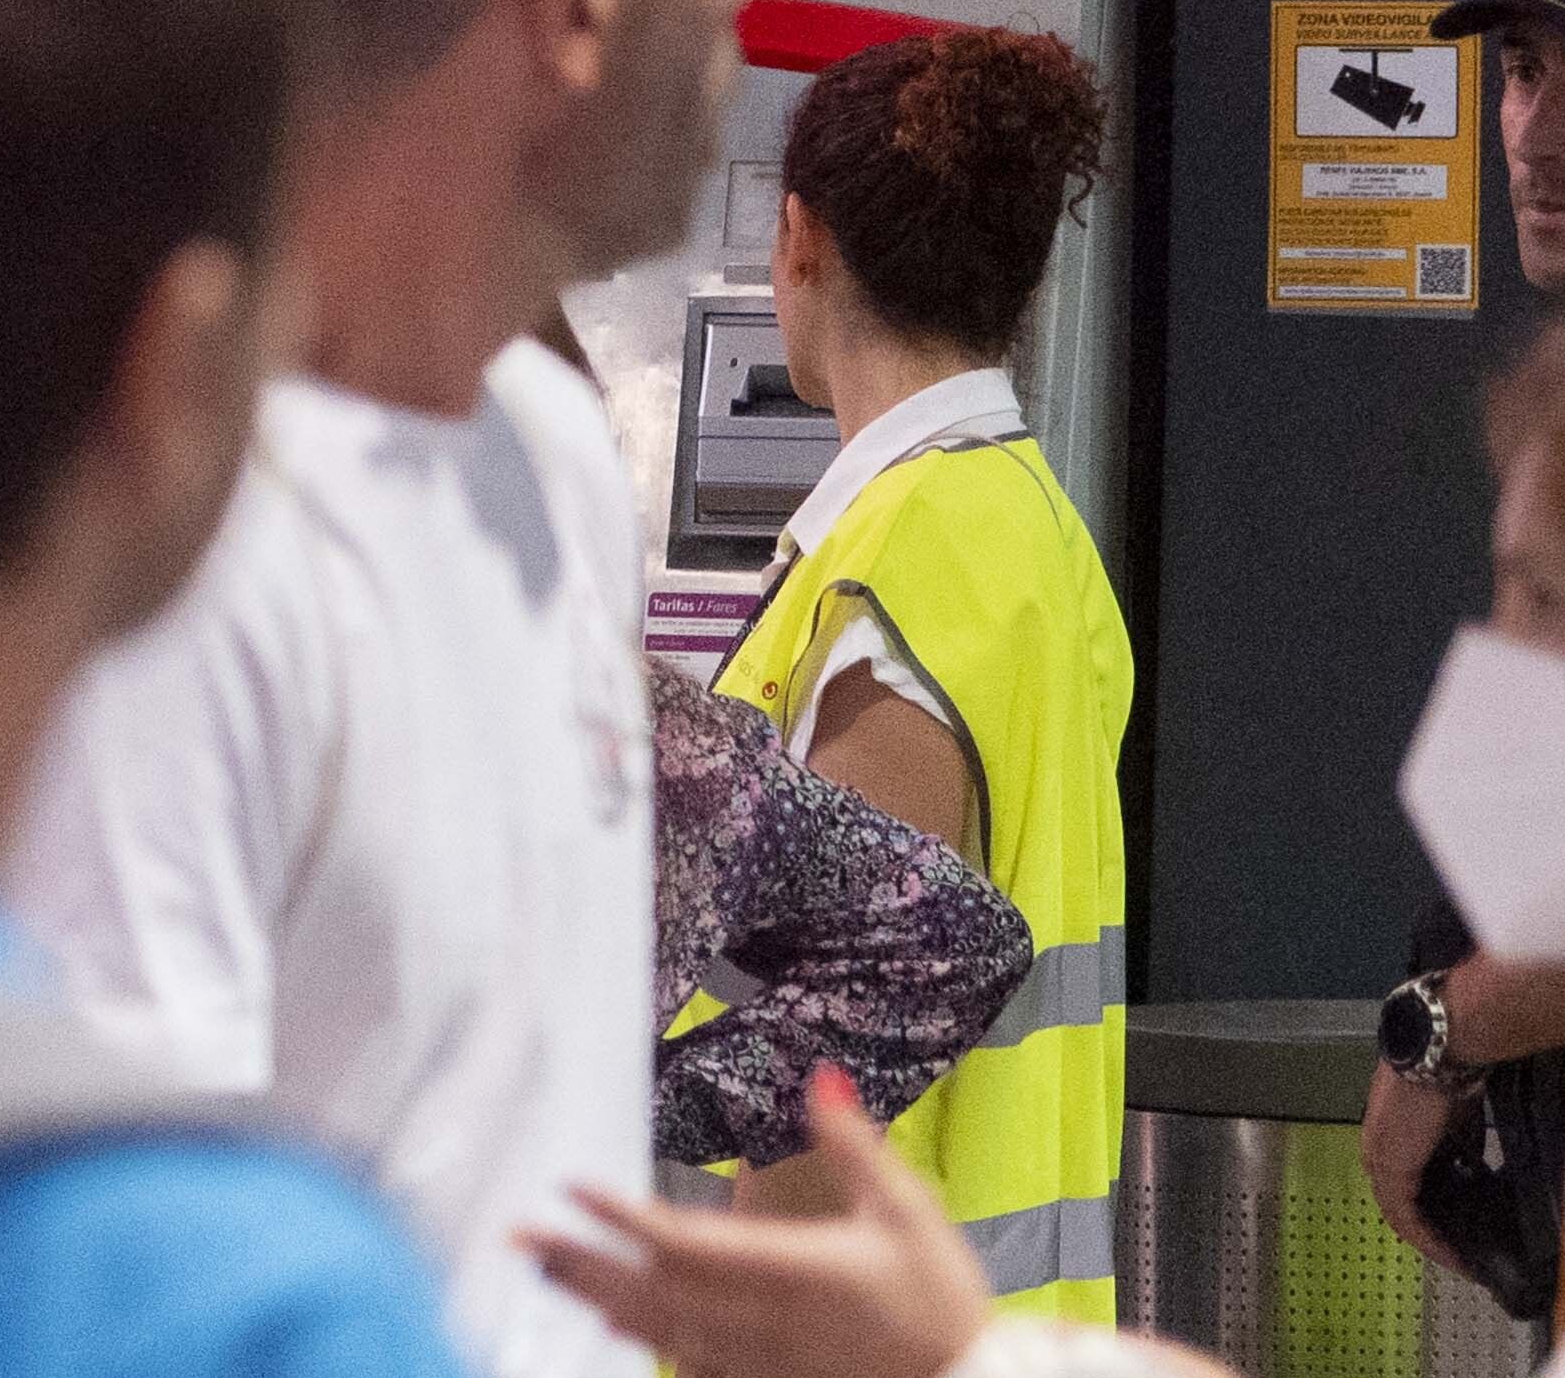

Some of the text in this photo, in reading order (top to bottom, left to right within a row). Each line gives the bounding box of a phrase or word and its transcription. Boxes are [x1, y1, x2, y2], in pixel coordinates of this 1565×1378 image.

[1297, 13, 1339, 26] ZONA
[652, 598, 695, 612] Tarifas
[706, 599, 738, 614] Fares
